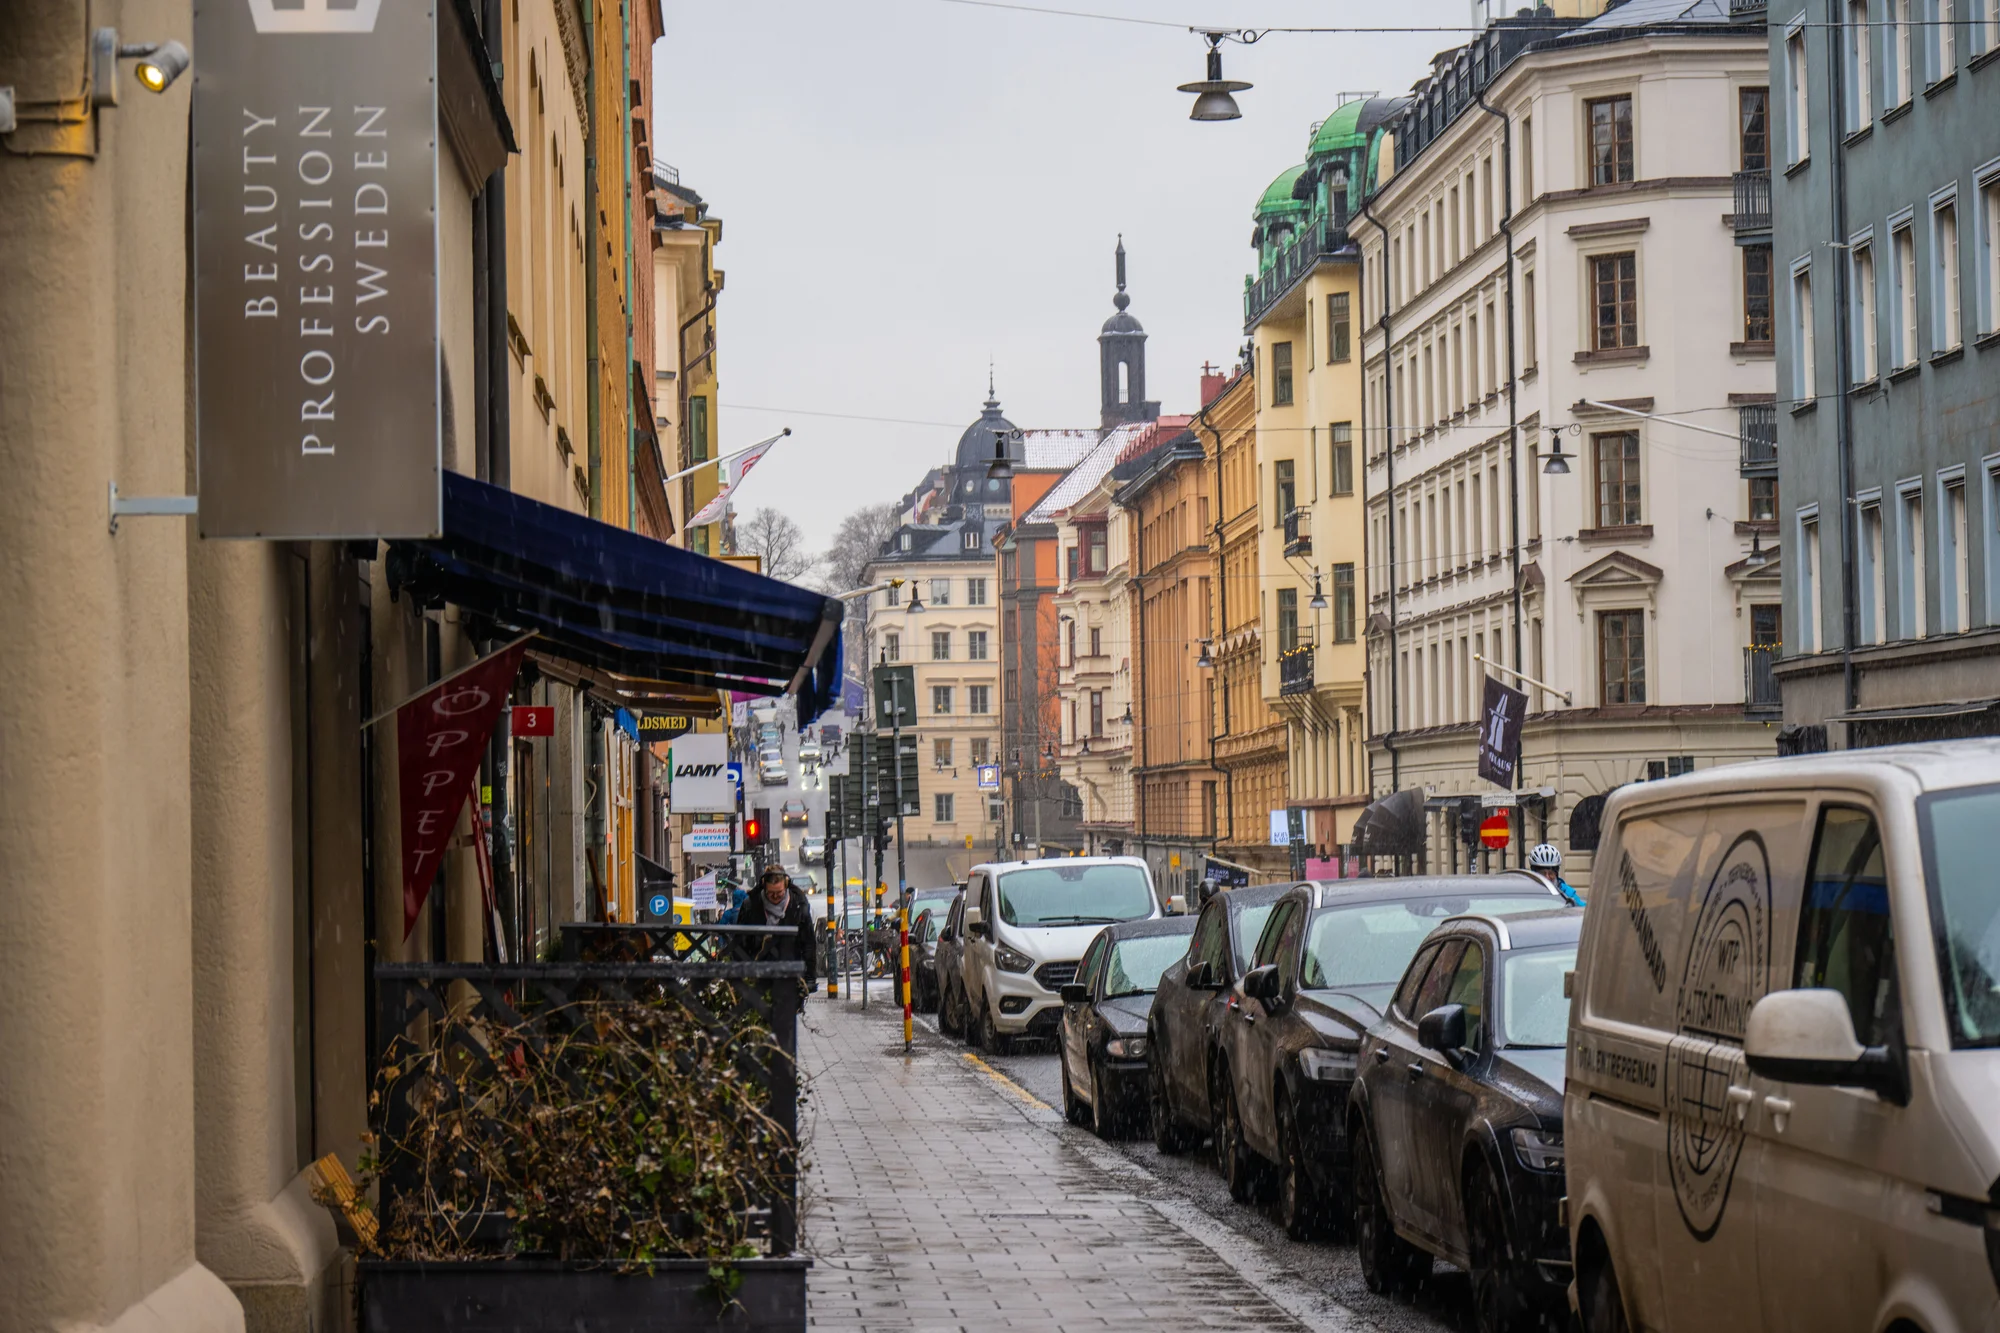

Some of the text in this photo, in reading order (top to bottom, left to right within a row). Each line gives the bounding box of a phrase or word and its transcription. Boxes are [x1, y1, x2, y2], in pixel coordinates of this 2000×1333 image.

[243, 107, 278, 319] BEAUTY
[354, 105, 389, 334] SWEDEN
[298, 105, 335, 456] PROFESSION
[526, 712, 537, 728] 3
[637, 716, 687, 730] LDSMED
[413, 686, 490, 874] ÖPPET
[675, 763, 724, 777] LAMY
[655, 900, 665, 912] P
[1718, 939, 1740, 974] WTP
